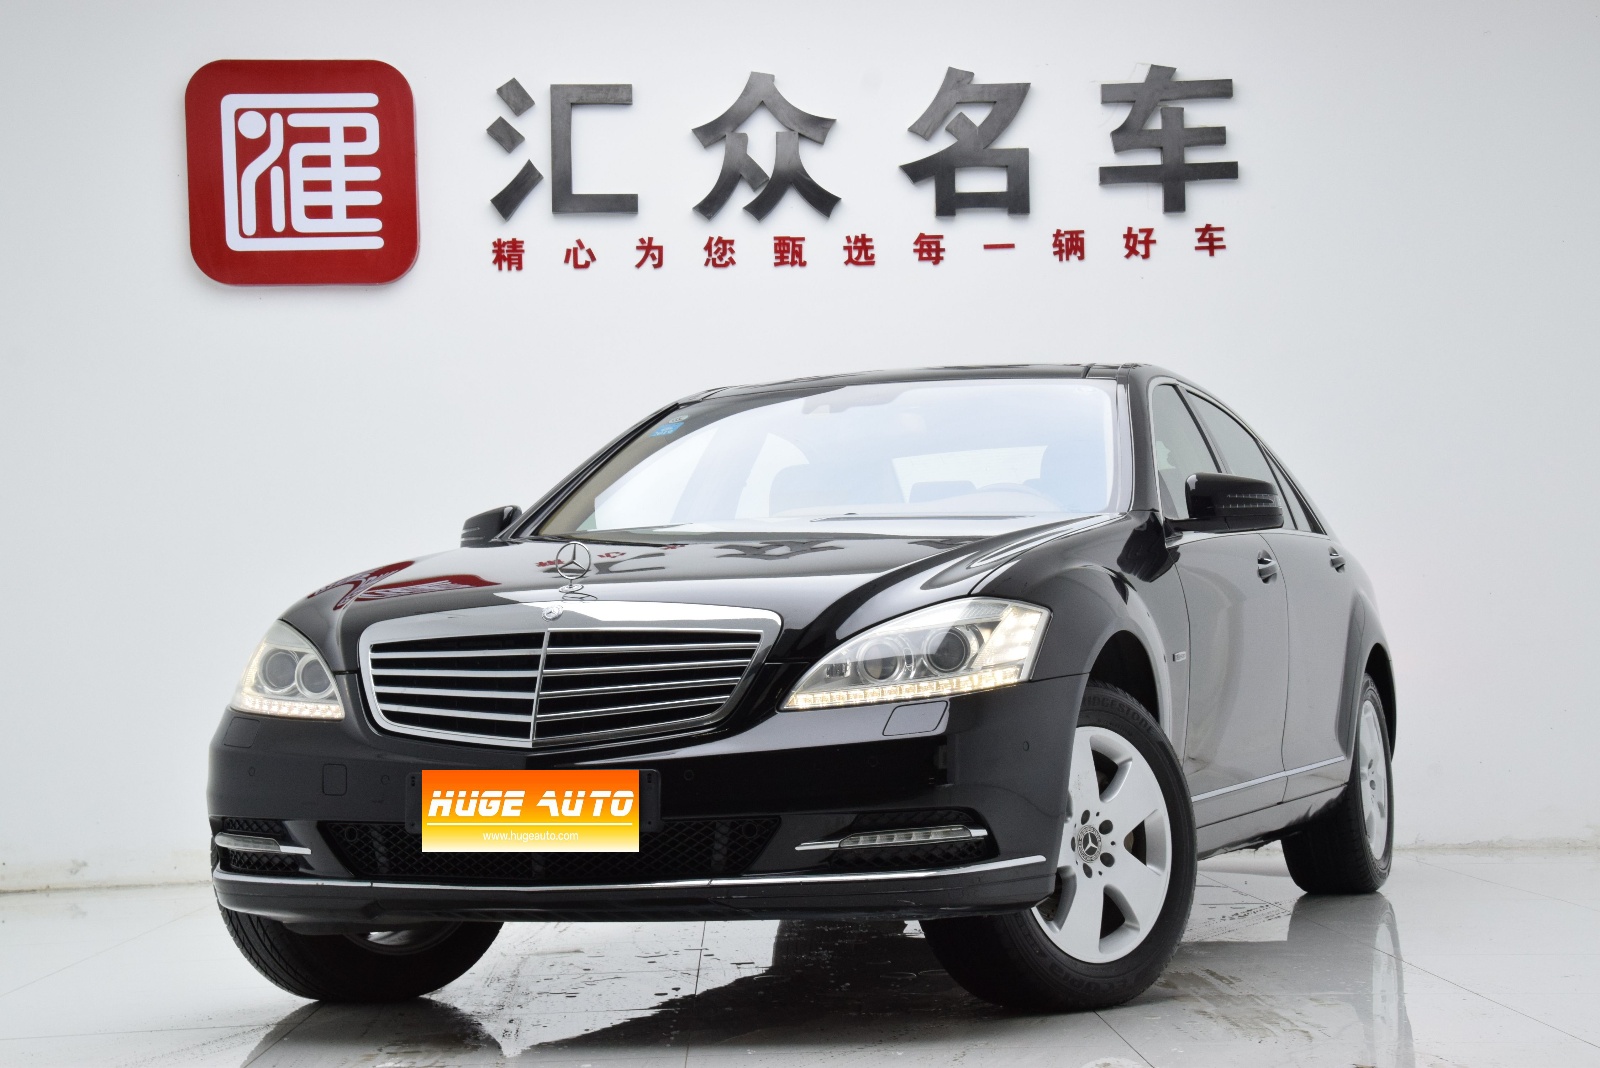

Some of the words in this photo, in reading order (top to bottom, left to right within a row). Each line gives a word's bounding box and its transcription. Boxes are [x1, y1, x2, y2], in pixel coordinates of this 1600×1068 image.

[486, 64, 1239, 222] 汇众名车
[492, 223, 1227, 271] 精心为您甄选每一辆好车
